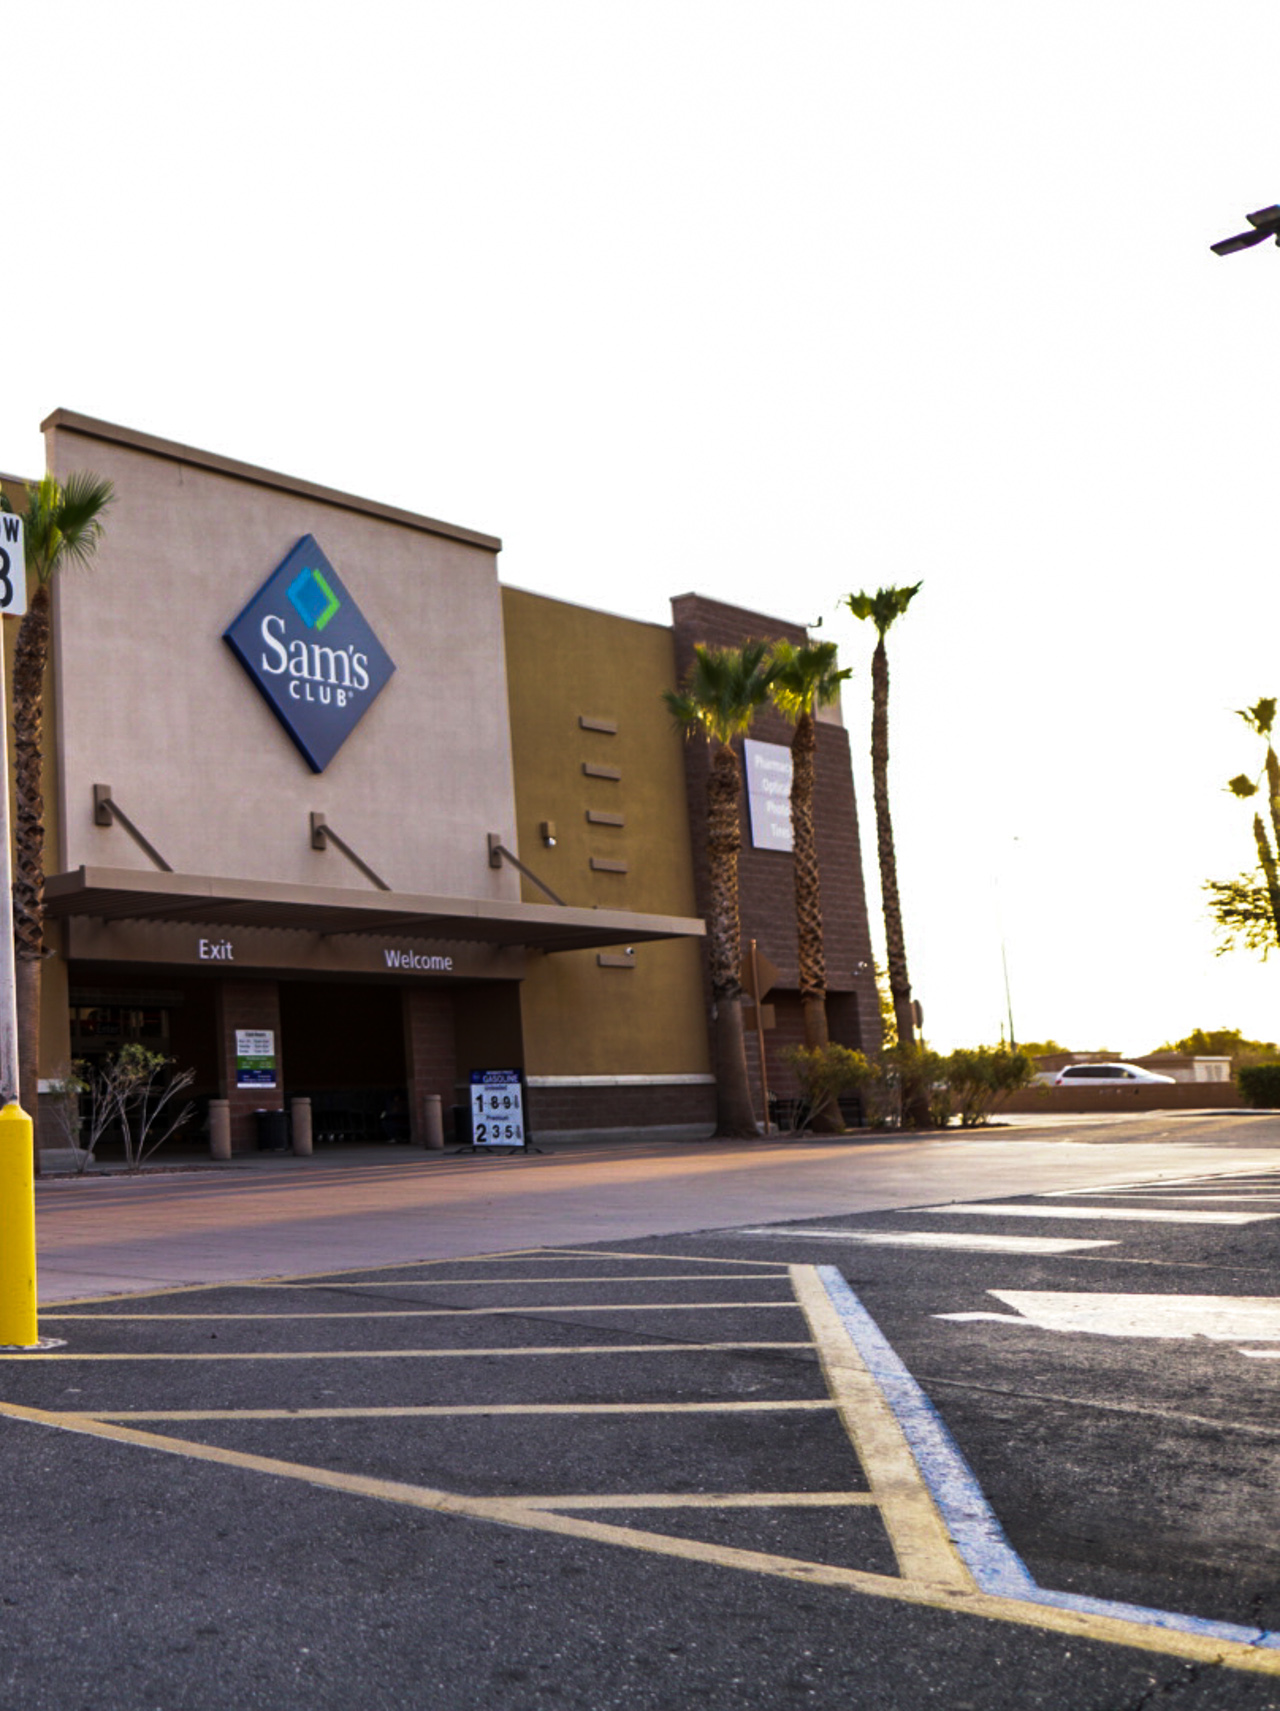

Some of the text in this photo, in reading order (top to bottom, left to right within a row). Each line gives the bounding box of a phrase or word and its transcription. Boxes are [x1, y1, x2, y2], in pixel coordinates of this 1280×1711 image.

[261, 615, 369, 690] Sam's
[289, 680, 347, 708] CLUB
[199, 939, 234, 960] Exit
[384, 949, 453, 970] Welcome
